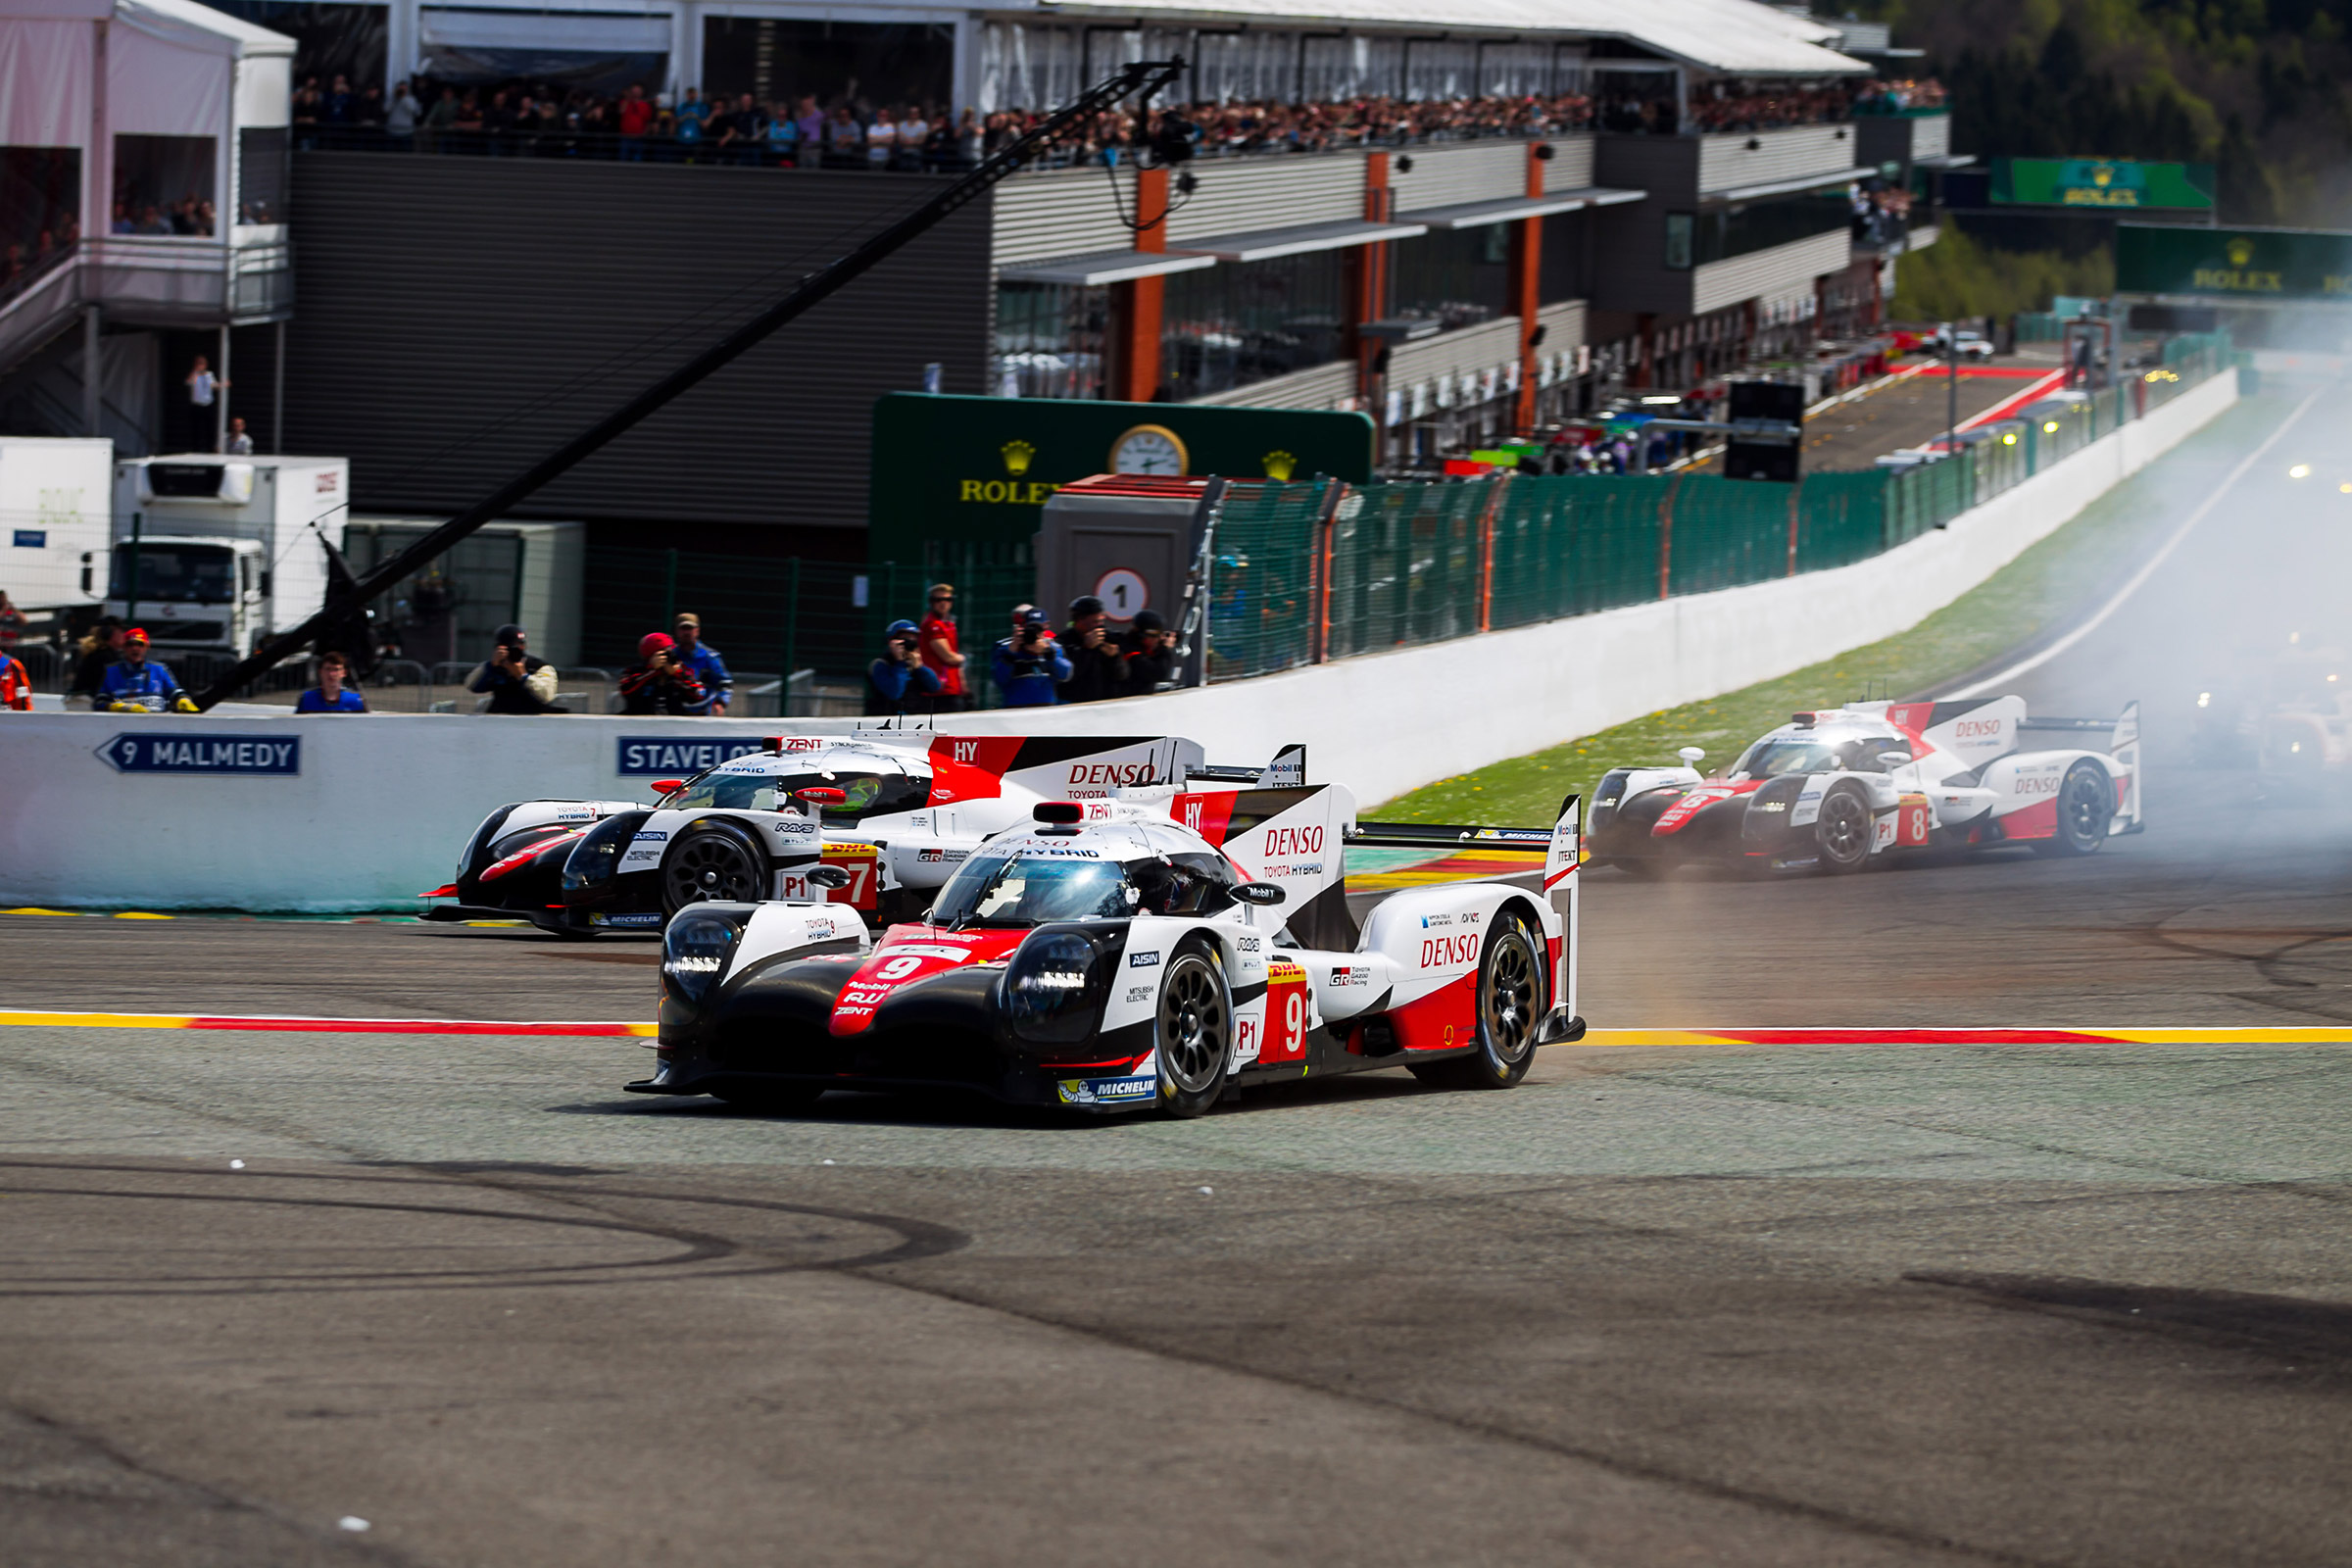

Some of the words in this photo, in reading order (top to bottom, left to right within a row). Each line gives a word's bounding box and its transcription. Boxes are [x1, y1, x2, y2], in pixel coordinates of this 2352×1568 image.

[2193, 269, 2282, 292] ROLEX
[1112, 584, 1127, 610] 1
[1956, 719, 2000, 737] DENSO
[786, 738, 823, 751] ZENT
[955, 742, 978, 761] HY
[122, 741, 138, 764] 9
[152, 741, 293, 767] MALMEDY
[1068, 764, 1155, 784] DENSO
[2015, 777, 2060, 794] DENSO
[1067, 790, 1107, 799] TOYOTA
[1681, 795, 1708, 808] 8
[590, 808, 596, 817] 7
[1186, 803, 1202, 830] HY
[775, 822, 815, 834] RAYS
[1879, 823, 1890, 839] P1
[1912, 808, 1925, 841] 8
[830, 844, 870, 853] DHL
[1265, 825, 1324, 858] DENSO
[1022, 849, 1100, 858] HYBRID
[1264, 865, 1290, 878] TOYOTA
[1292, 863, 1322, 875] HYBRID
[785, 877, 806, 897] P1
[848, 863, 870, 903] 7
[806, 918, 829, 928] TOYOTA
[830, 920, 835, 933] 9
[808, 930, 831, 940] HYBRID
[1237, 937, 1259, 952] RAYS
[1421, 933, 1478, 968] DENSO
[1132, 953, 1157, 965] AISIN
[876, 956, 922, 979] 9
[1270, 963, 1300, 977] DHL
[849, 981, 890, 990] Mobil
[1331, 974, 1349, 985] GR
[835, 1006, 872, 1015] ZENT
[1286, 992, 1302, 1052] 9
[1239, 1021, 1255, 1050] P1
[1098, 1079, 1154, 1095] MICHELIN
